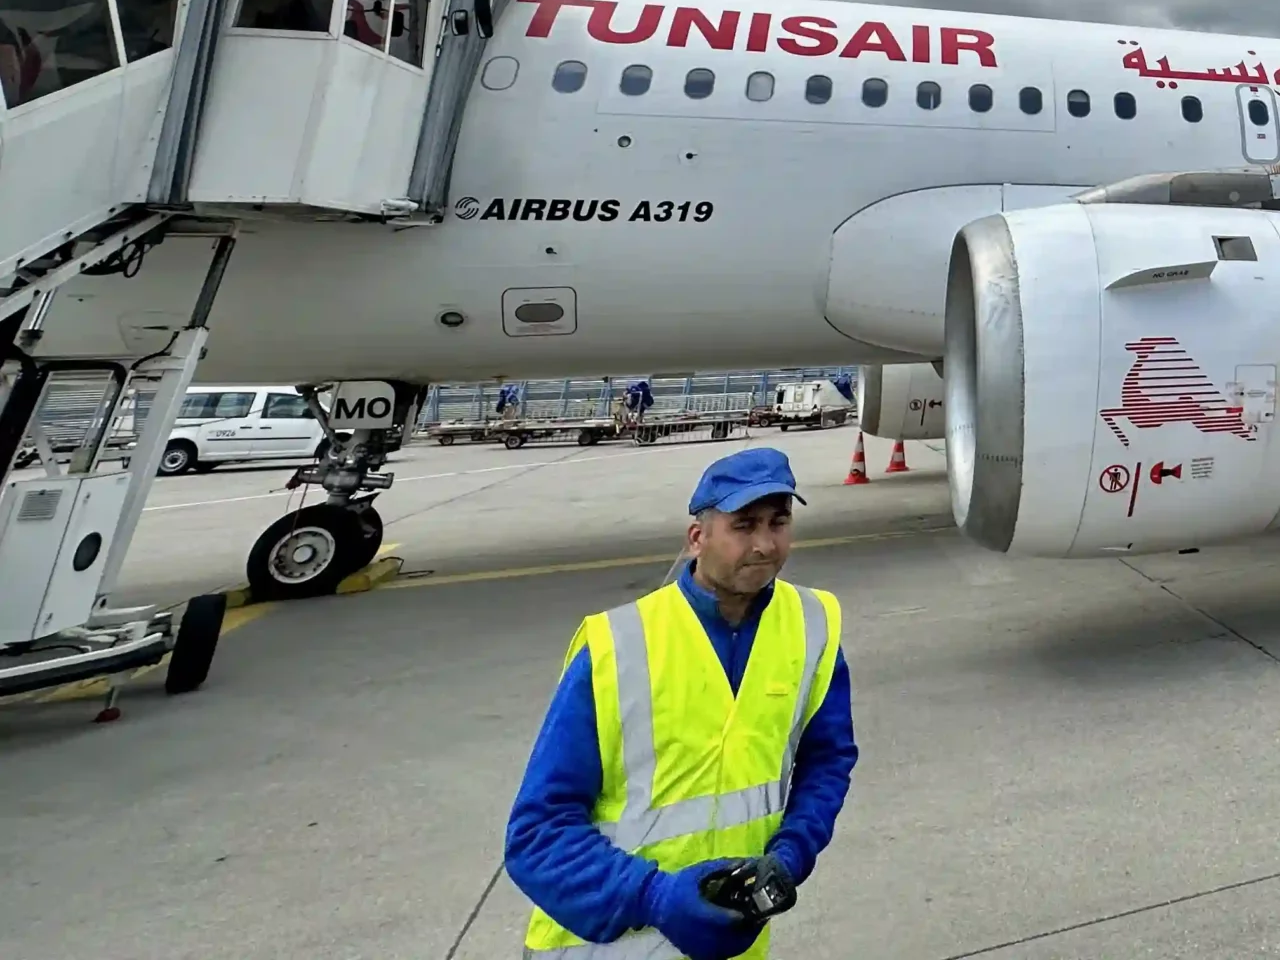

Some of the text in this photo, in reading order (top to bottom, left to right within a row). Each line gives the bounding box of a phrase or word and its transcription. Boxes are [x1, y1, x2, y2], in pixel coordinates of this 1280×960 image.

[479, 198, 714, 223] AIRBUS A319
[335, 396, 391, 420] MO
